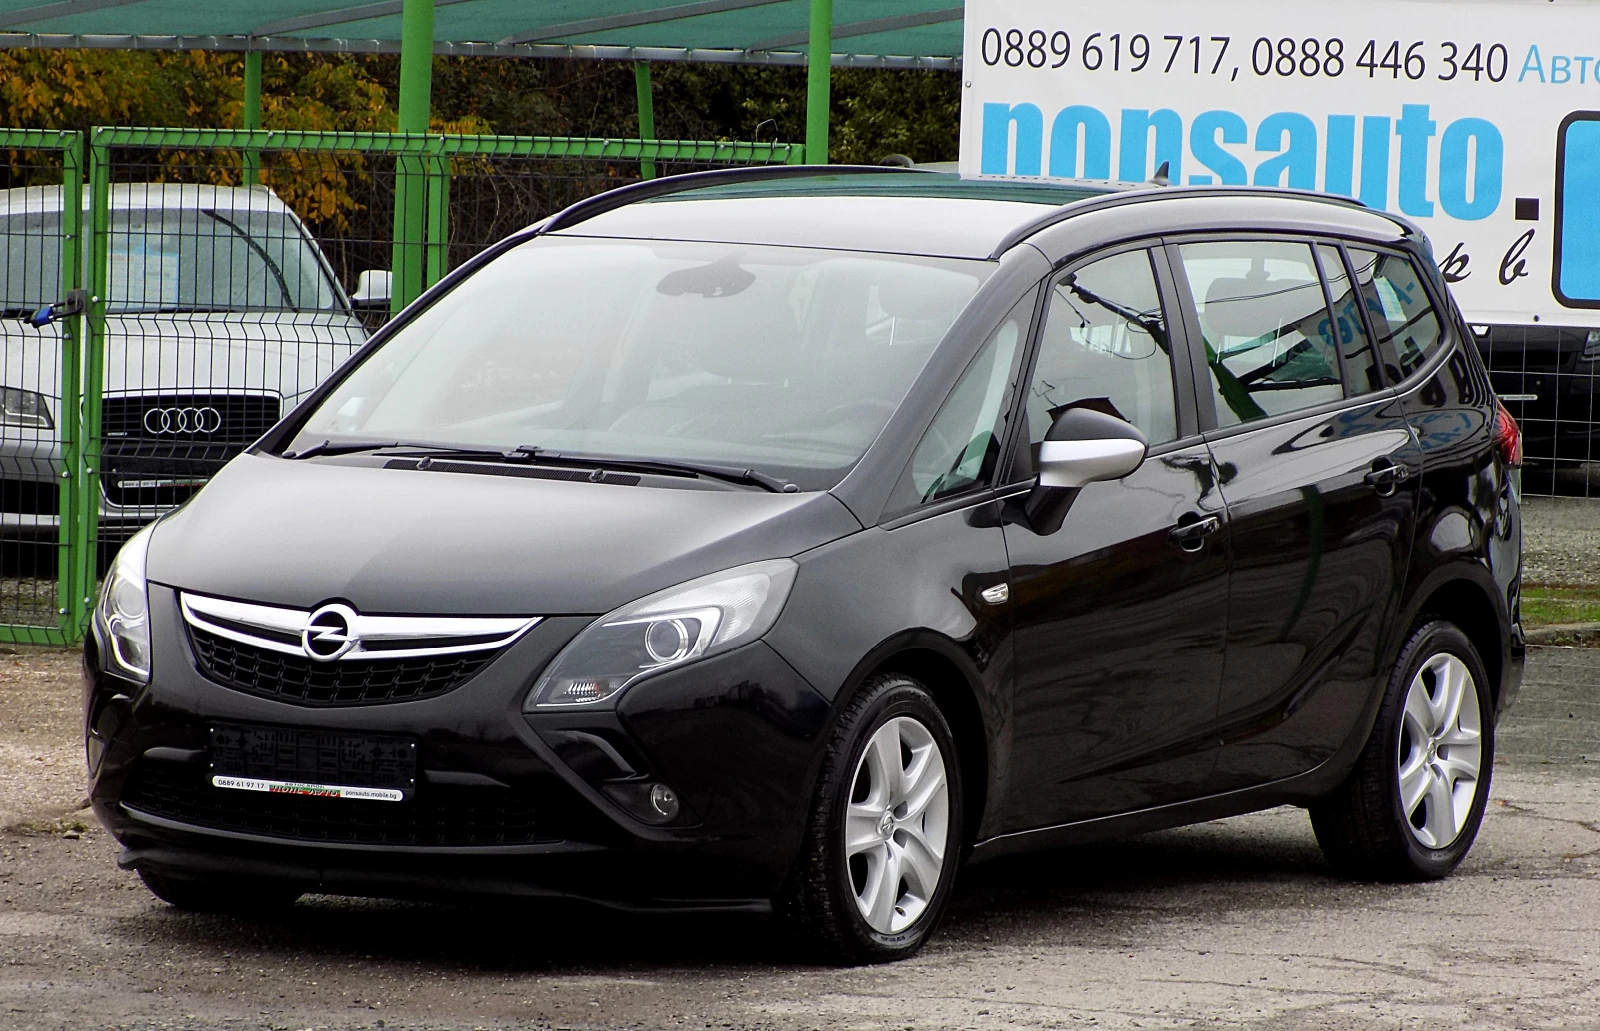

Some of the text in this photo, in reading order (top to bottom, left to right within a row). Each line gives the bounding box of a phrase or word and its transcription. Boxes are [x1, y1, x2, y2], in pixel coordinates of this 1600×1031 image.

[981, 27, 1508, 83] 0889 619 717, 0888 446 340
